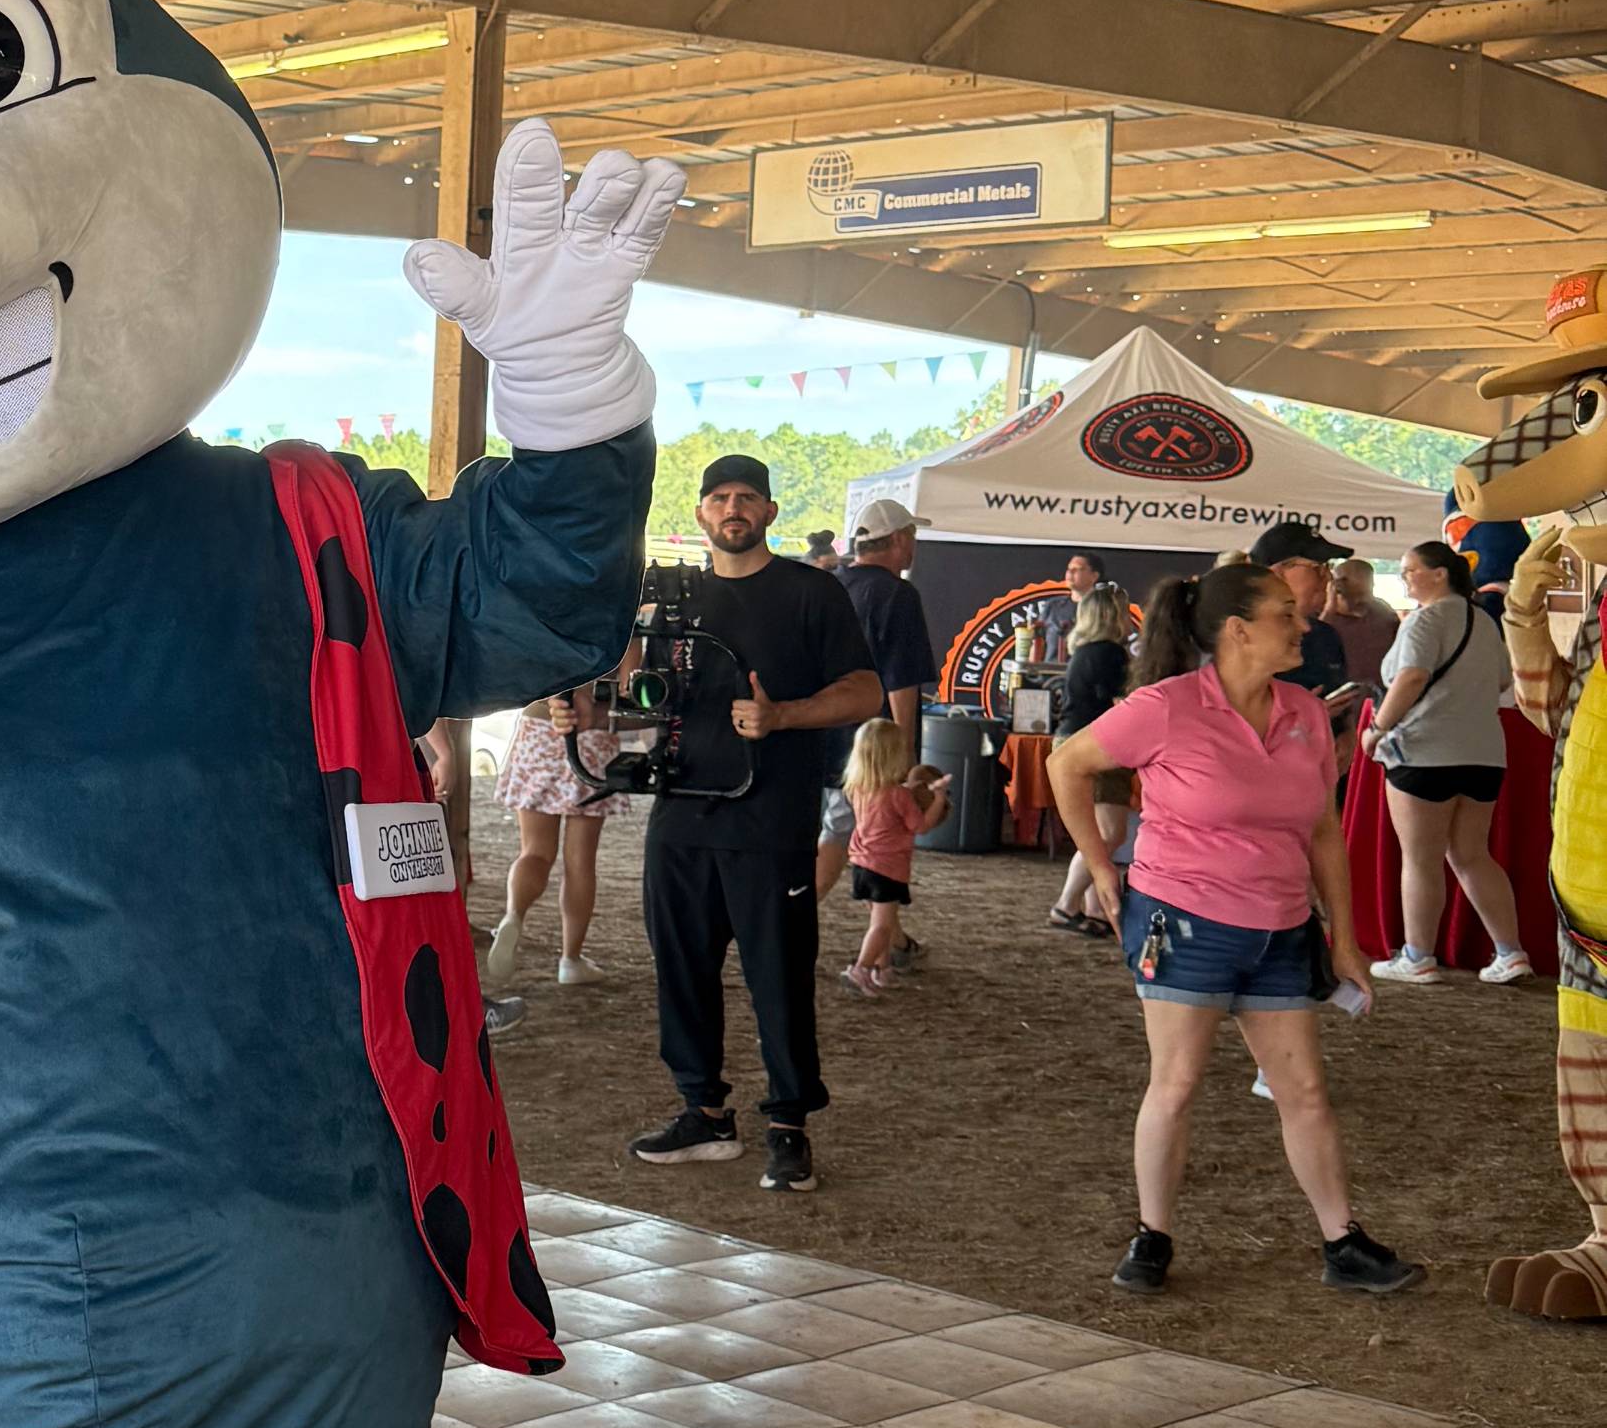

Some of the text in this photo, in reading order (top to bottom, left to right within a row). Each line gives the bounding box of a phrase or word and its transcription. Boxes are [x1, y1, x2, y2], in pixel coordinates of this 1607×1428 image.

[833, 183, 1032, 212] CMC Commercial Metals
[1152, 403, 1216, 430] BREWING
[984, 491, 1396, 534] www.rustyaxebrewing.com
[961, 623, 1005, 684] RUSTY
[379, 820, 444, 861] JOHNNIE
[390, 861, 409, 883] ON
[407, 857, 427, 880] THE
